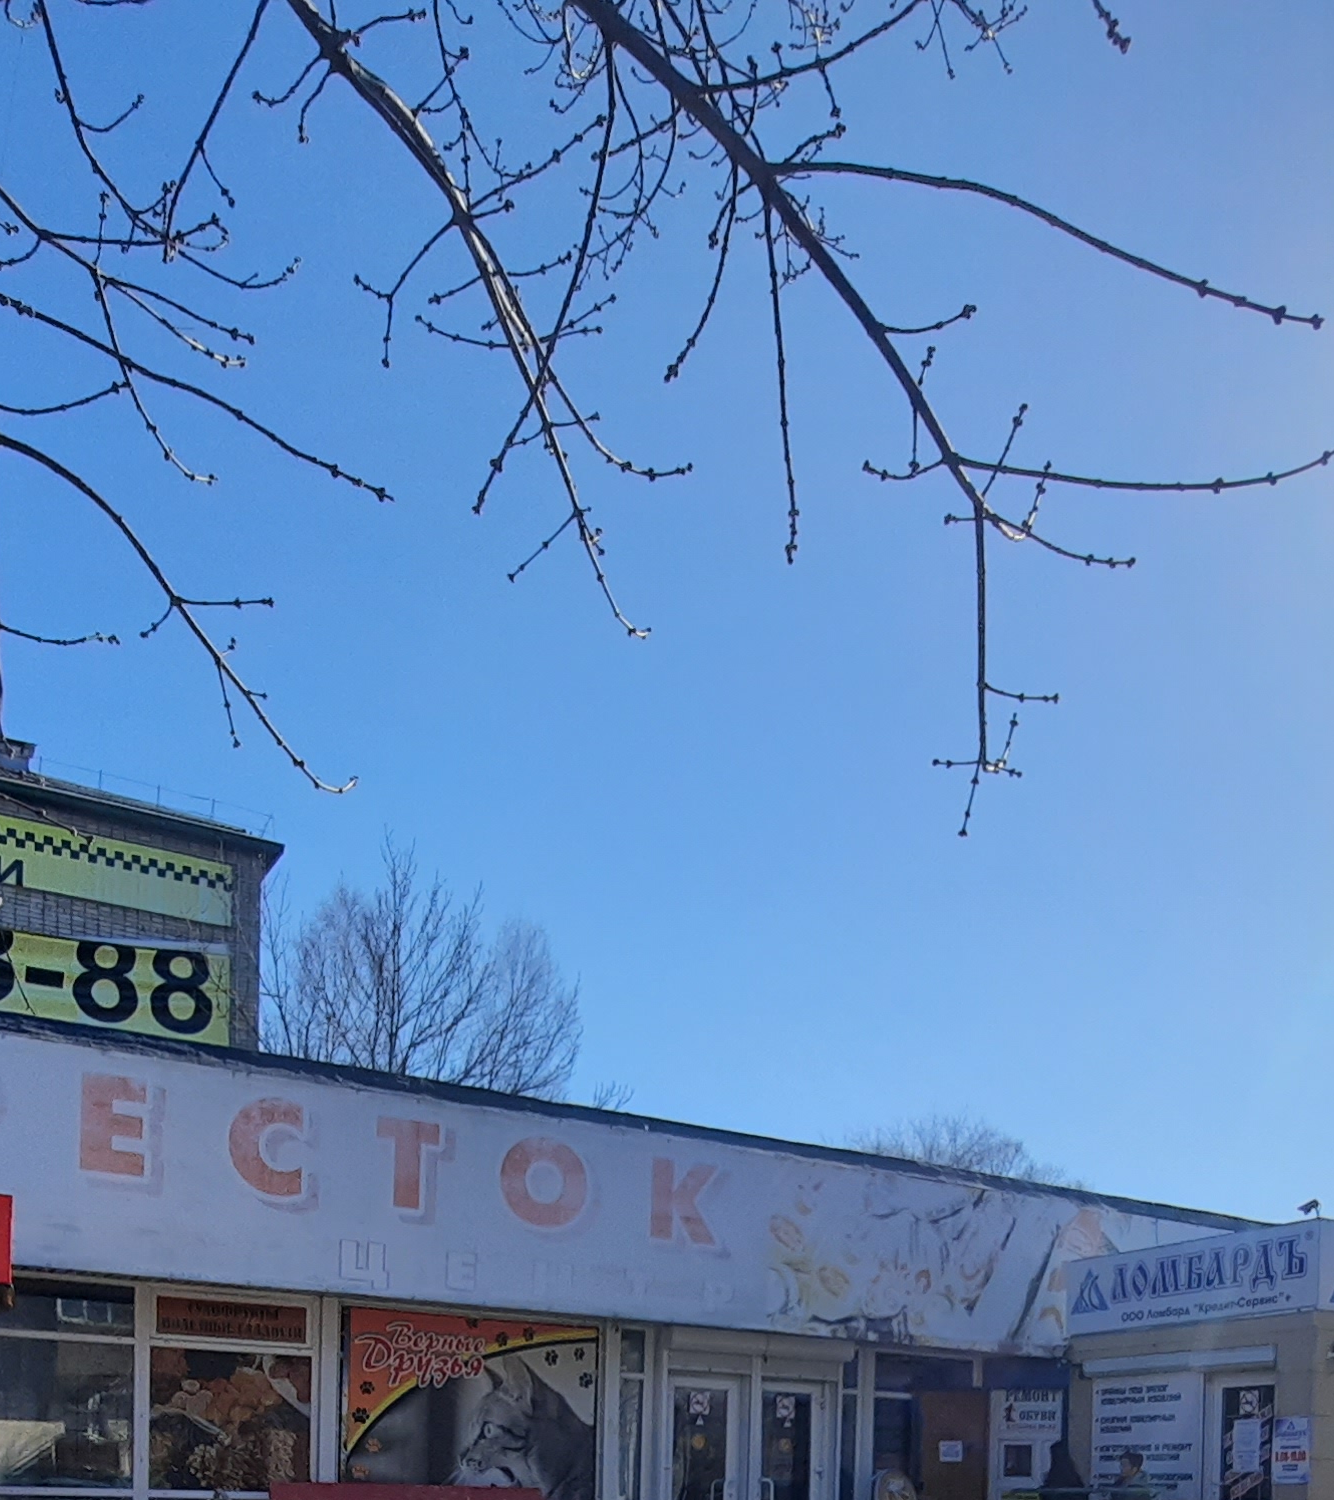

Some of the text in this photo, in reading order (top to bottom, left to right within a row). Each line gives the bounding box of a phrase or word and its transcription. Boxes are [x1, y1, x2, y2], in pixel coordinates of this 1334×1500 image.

[1109, 1235, 1308, 1303] ЛОМБАРДЪ
[1121, 1309, 1144, 1323] ООО
[1146, 1306, 1190, 1321] Ломбард
[354, 1332, 485, 1388] Друзья
[386, 1320, 485, 1355] Верные
